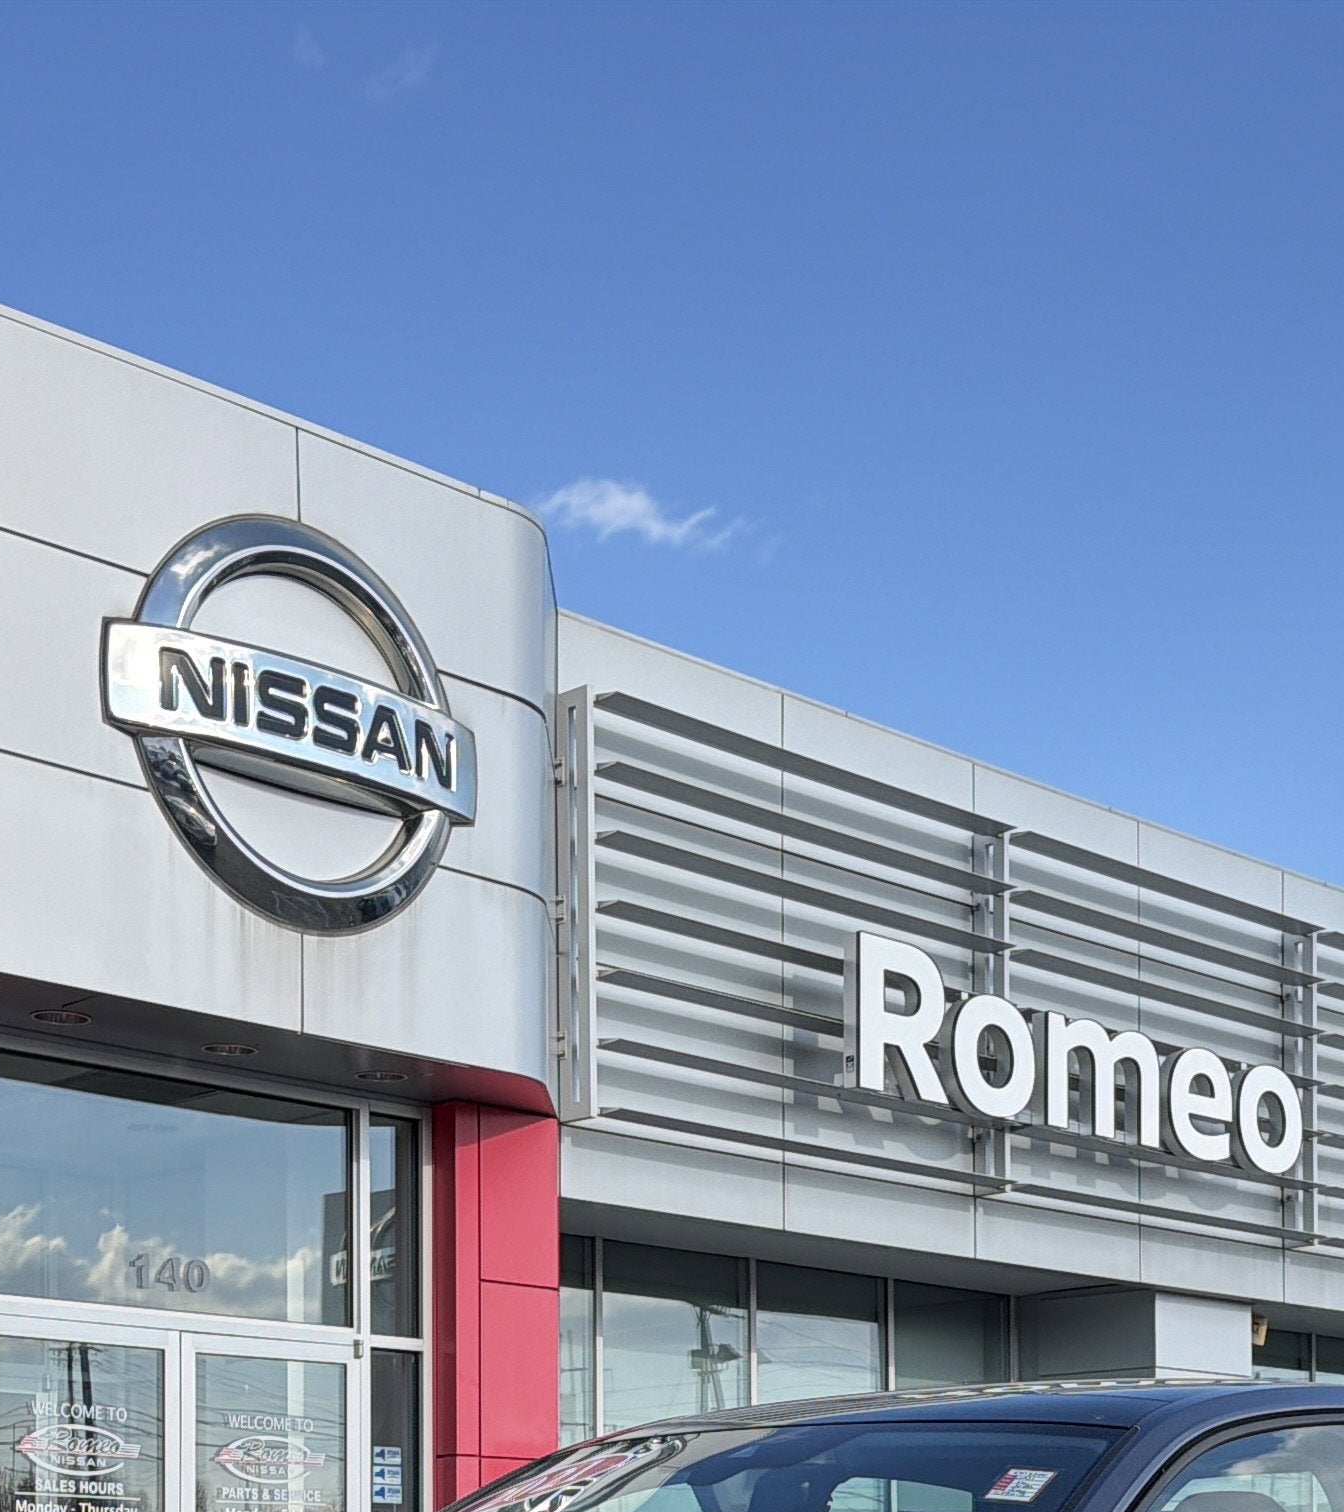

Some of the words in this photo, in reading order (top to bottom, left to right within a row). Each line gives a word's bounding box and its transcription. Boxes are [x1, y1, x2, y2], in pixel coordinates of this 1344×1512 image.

[158, 646, 458, 793] NISSAN
[852, 930, 1303, 1175] Romeo
[129, 1252, 210, 1293] 140
[31, 1400, 103, 1421] WELCOME
[107, 1406, 128, 1422] TO
[228, 1414, 294, 1431] WELCOME
[296, 1418, 314, 1433] TO
[43, 1427, 121, 1454] Romeo
[240, 1438, 307, 1463] Rom
[50, 1455, 107, 1467] NISSAN
[246, 1464, 292, 1476] NISSA
[35, 1479, 76, 1493] SALES
[79, 1481, 124, 1496] HOURS
[222, 1486, 259, 1499] PARTS
[262, 1488, 271, 1500] &
